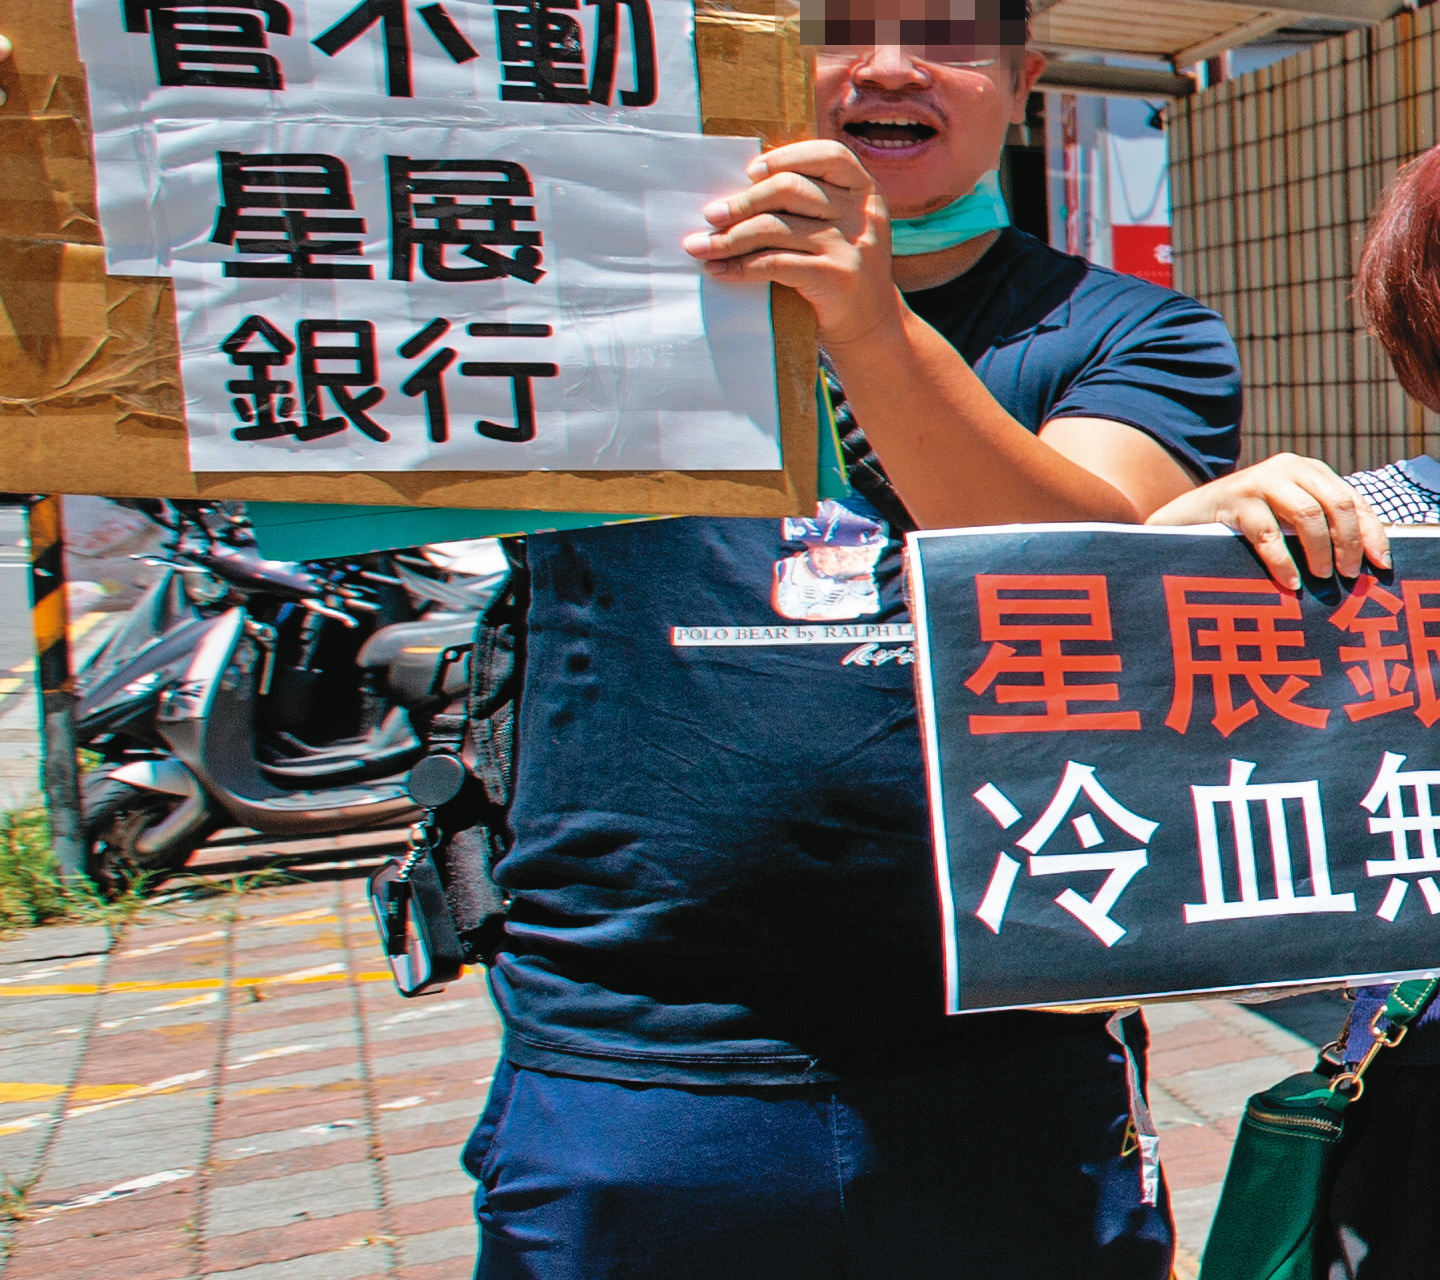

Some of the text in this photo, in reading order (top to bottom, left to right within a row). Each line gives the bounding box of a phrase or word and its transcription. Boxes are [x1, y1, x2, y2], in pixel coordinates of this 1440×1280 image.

[210, 151, 549, 285] 星展
[221, 315, 559, 444] 銀行
[677, 628, 729, 641] POLO
[737, 627, 789, 640] BEAR
[796, 626, 817, 641] by
[824, 624, 891, 638] RALPH
